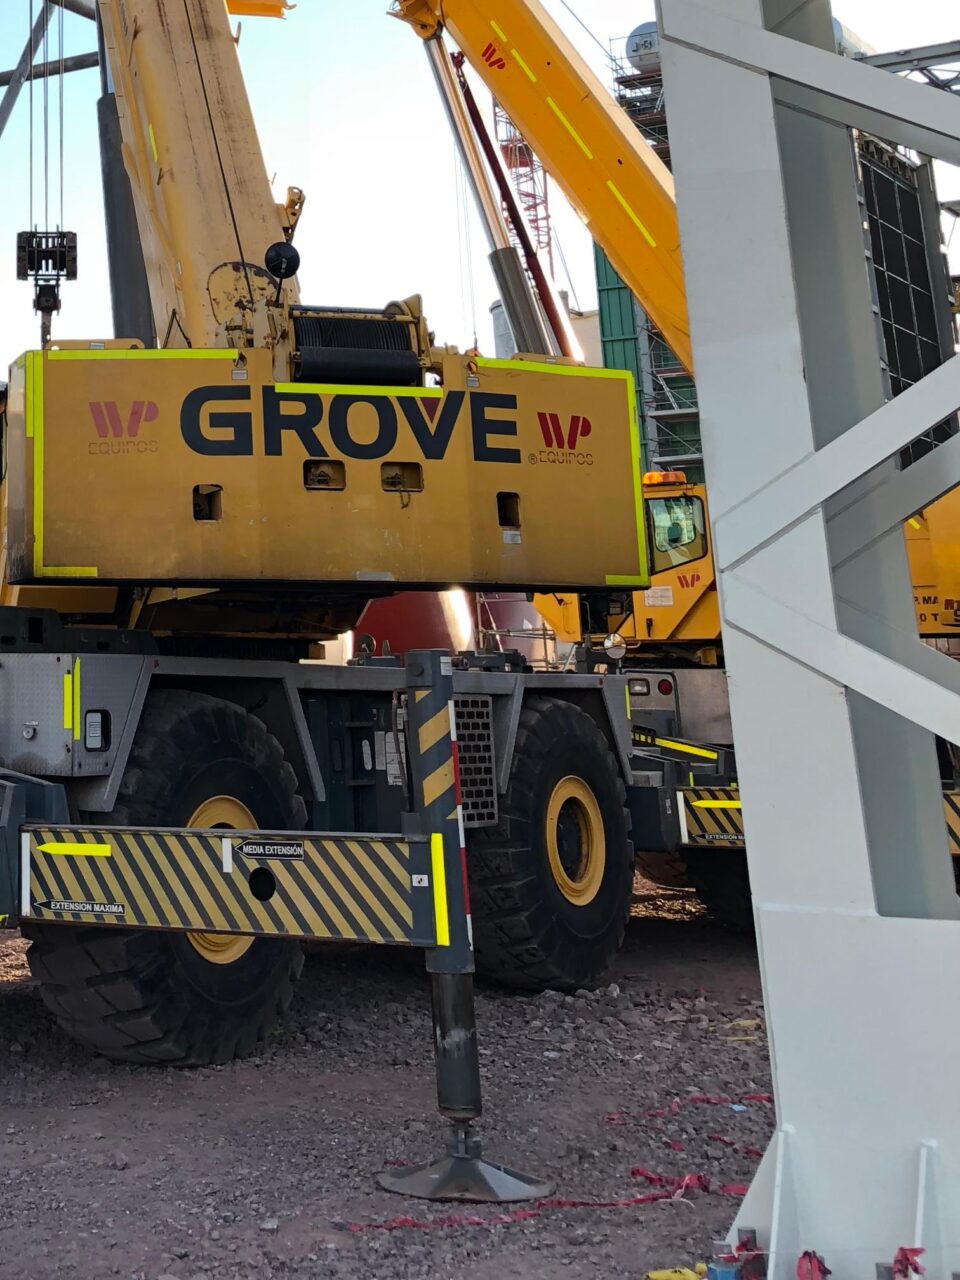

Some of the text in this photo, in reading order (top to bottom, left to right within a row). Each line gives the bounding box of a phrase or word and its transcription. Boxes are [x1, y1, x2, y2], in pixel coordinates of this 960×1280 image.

[180, 385, 522, 464] GROVE
[539, 450, 594, 466] EQUIPOS
[243, 844, 303, 856] MEDIA EXTENSIÓN
[51, 901, 124, 914] EXTENSION MAXIMA
